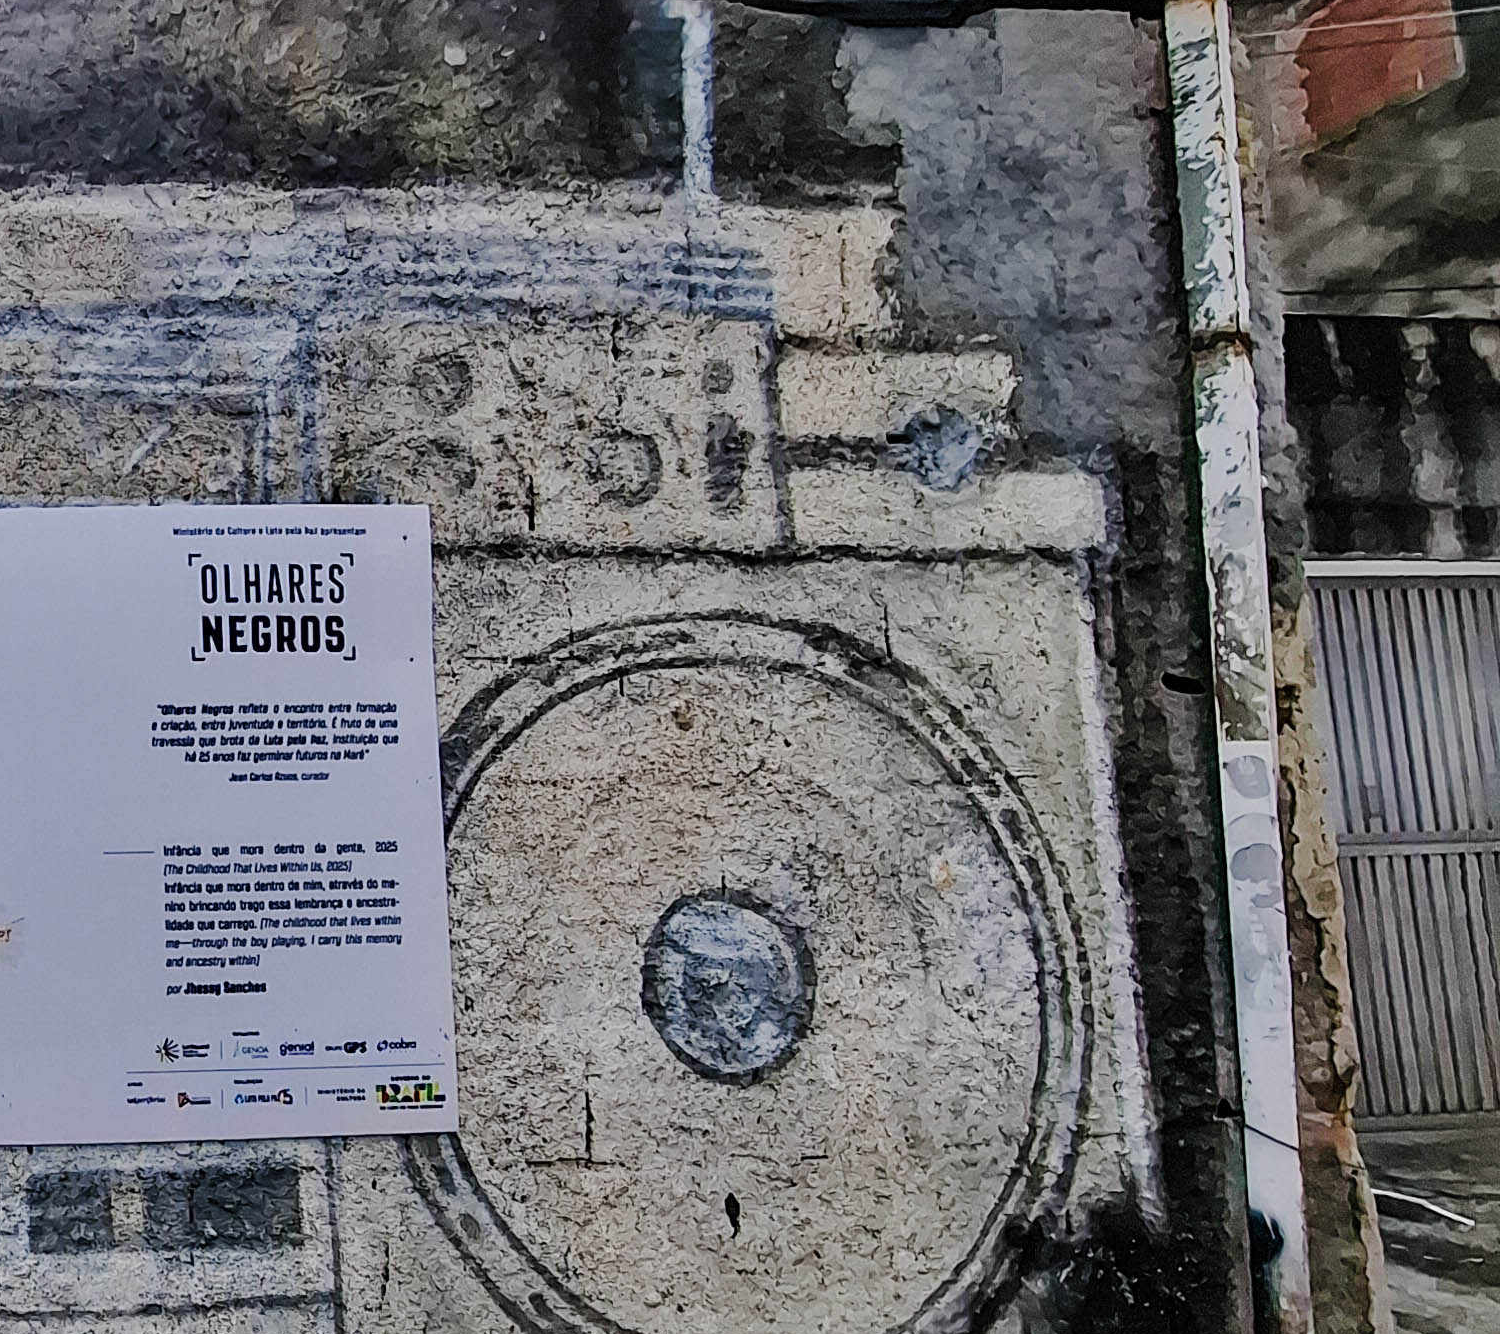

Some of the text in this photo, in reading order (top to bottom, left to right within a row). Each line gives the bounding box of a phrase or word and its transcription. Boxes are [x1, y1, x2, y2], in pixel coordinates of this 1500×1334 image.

[201, 564, 344, 603] OLHARES
[202, 616, 345, 652] NEGROS
[202, 704, 233, 716] Negros
[239, 703, 268, 714] reflete
[274, 705, 279, 713] o
[284, 704, 323, 713] encontro
[329, 704, 351, 713] entre
[357, 702, 396, 713] formação
[152, 717, 397, 732] e criação, entre juventude e território. É fruto de uma
[152, 736, 195, 747] travessia
[199, 737, 216, 748] que
[221, 735, 244, 745] brota
[249, 735, 260, 745] da
[264, 735, 283, 746] Luta
[287, 734, 306, 746] pela
[383, 735, 398, 745] que
[185, 751, 196, 762] há
[199, 751, 210, 762] 25
[213, 753, 235, 762] anos
[238, 751, 251, 761] faz
[254, 751, 293, 763] germinar
[296, 750, 328, 760] futuros
[331, 752, 341, 760] na
[164, 841, 397, 857] Infância que mora dentro da gente, 2025
[186, 864, 230, 874] Childhood
[234, 863, 252, 873] That
[255, 863, 277, 873] Lives
[281, 863, 308, 872] Within
[311, 862, 323, 872] Us,
[165, 878, 399, 894] Infância que mora dentro de mim, através do me-
[165, 897, 399, 912] nino brincando trago essa lembrança e ancestra-
[165, 920, 194, 931] lidade
[198, 921, 215, 931] que
[218, 920, 257, 931] carrego.
[283, 917, 327, 928] childhood
[330, 917, 347, 926] that
[351, 917, 371, 925] lives
[375, 916, 401, 925] within
[232, 937, 247, 947] the
[251, 937, 268, 948] boy
[272, 936, 307, 948] playing,
[318, 937, 341, 946] carry
[346, 935, 362, 944] this
[366, 935, 402, 945] memory
[166, 956, 183, 967] and
[186, 957, 226, 968] ancestry
[167, 986, 182, 995] por
[224, 981, 266, 993] Sanches
[280, 1041, 314, 1056] genial
[344, 1041, 367, 1053] GPS
[389, 1037, 416, 1049] cobra
